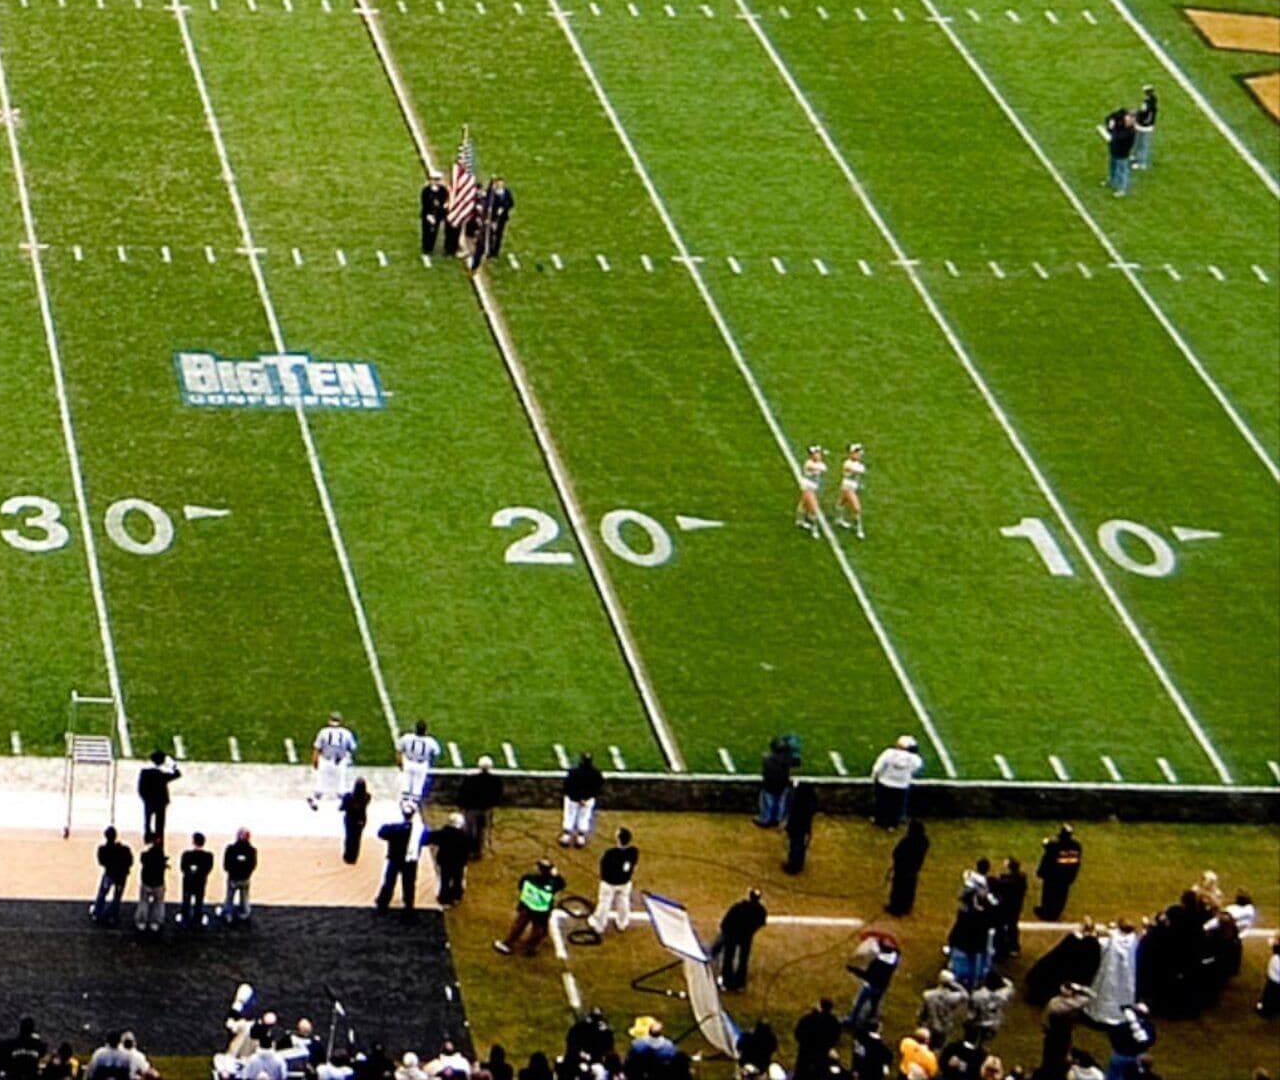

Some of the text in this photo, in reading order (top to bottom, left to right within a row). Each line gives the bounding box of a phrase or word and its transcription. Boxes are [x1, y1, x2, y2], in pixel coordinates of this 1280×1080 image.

[0, 495, 175, 555] 30
[491, 506, 673, 566] 20
[999, 517, 1176, 577] 10
